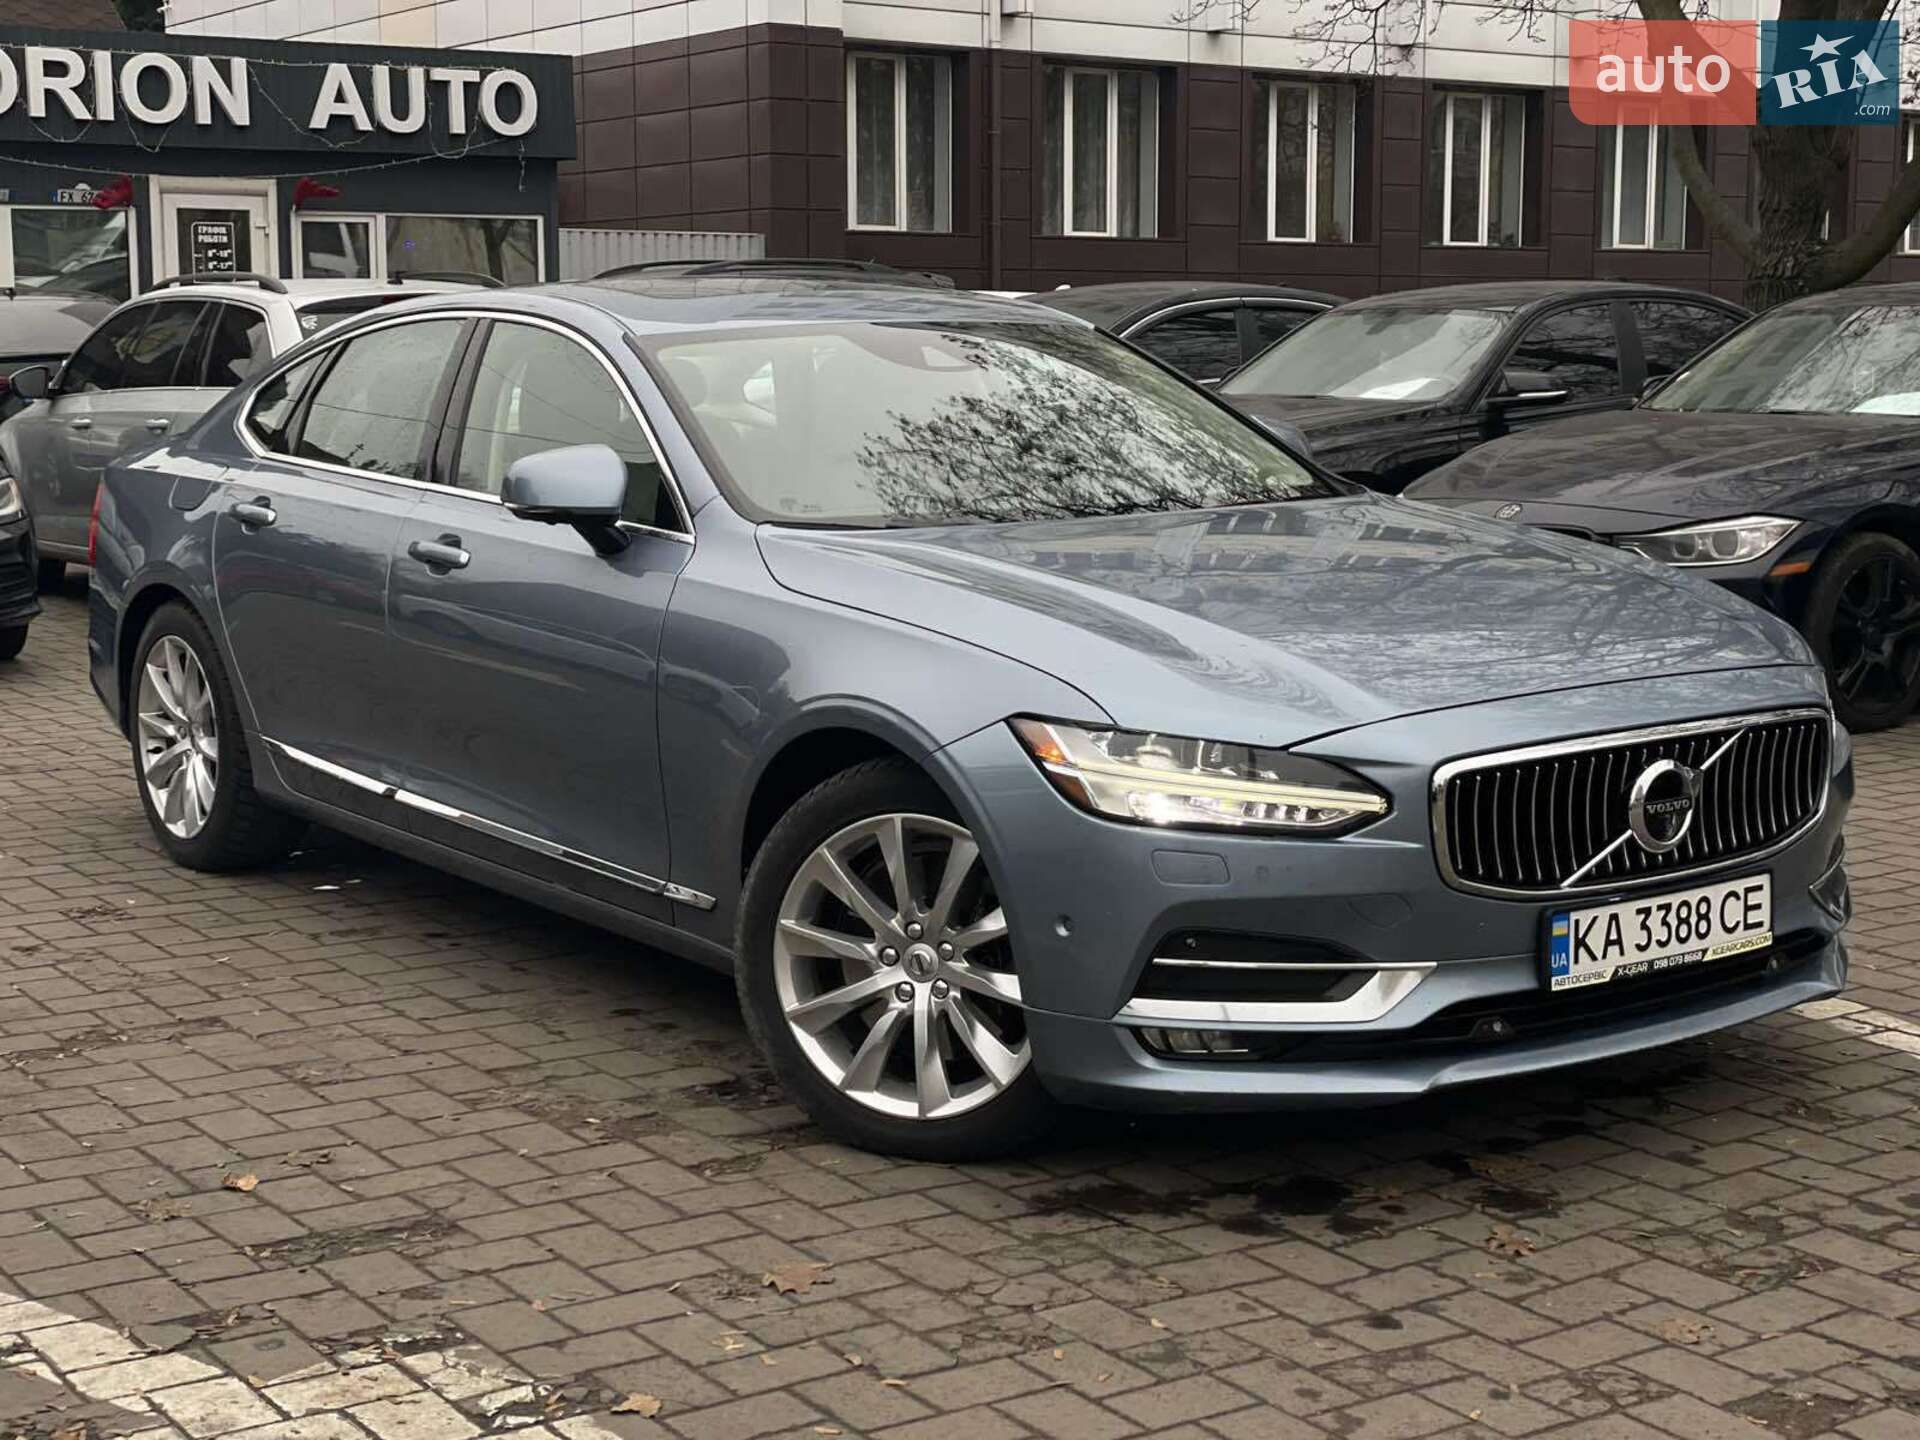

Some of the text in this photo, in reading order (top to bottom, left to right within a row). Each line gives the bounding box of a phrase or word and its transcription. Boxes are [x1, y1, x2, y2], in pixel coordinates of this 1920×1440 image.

[0, 46, 538, 137] RION AUTO
[1646, 799, 1690, 814] VOLVO
[1573, 884, 1765, 965] KA 3388 CE
[1552, 952, 1568, 968] UA
